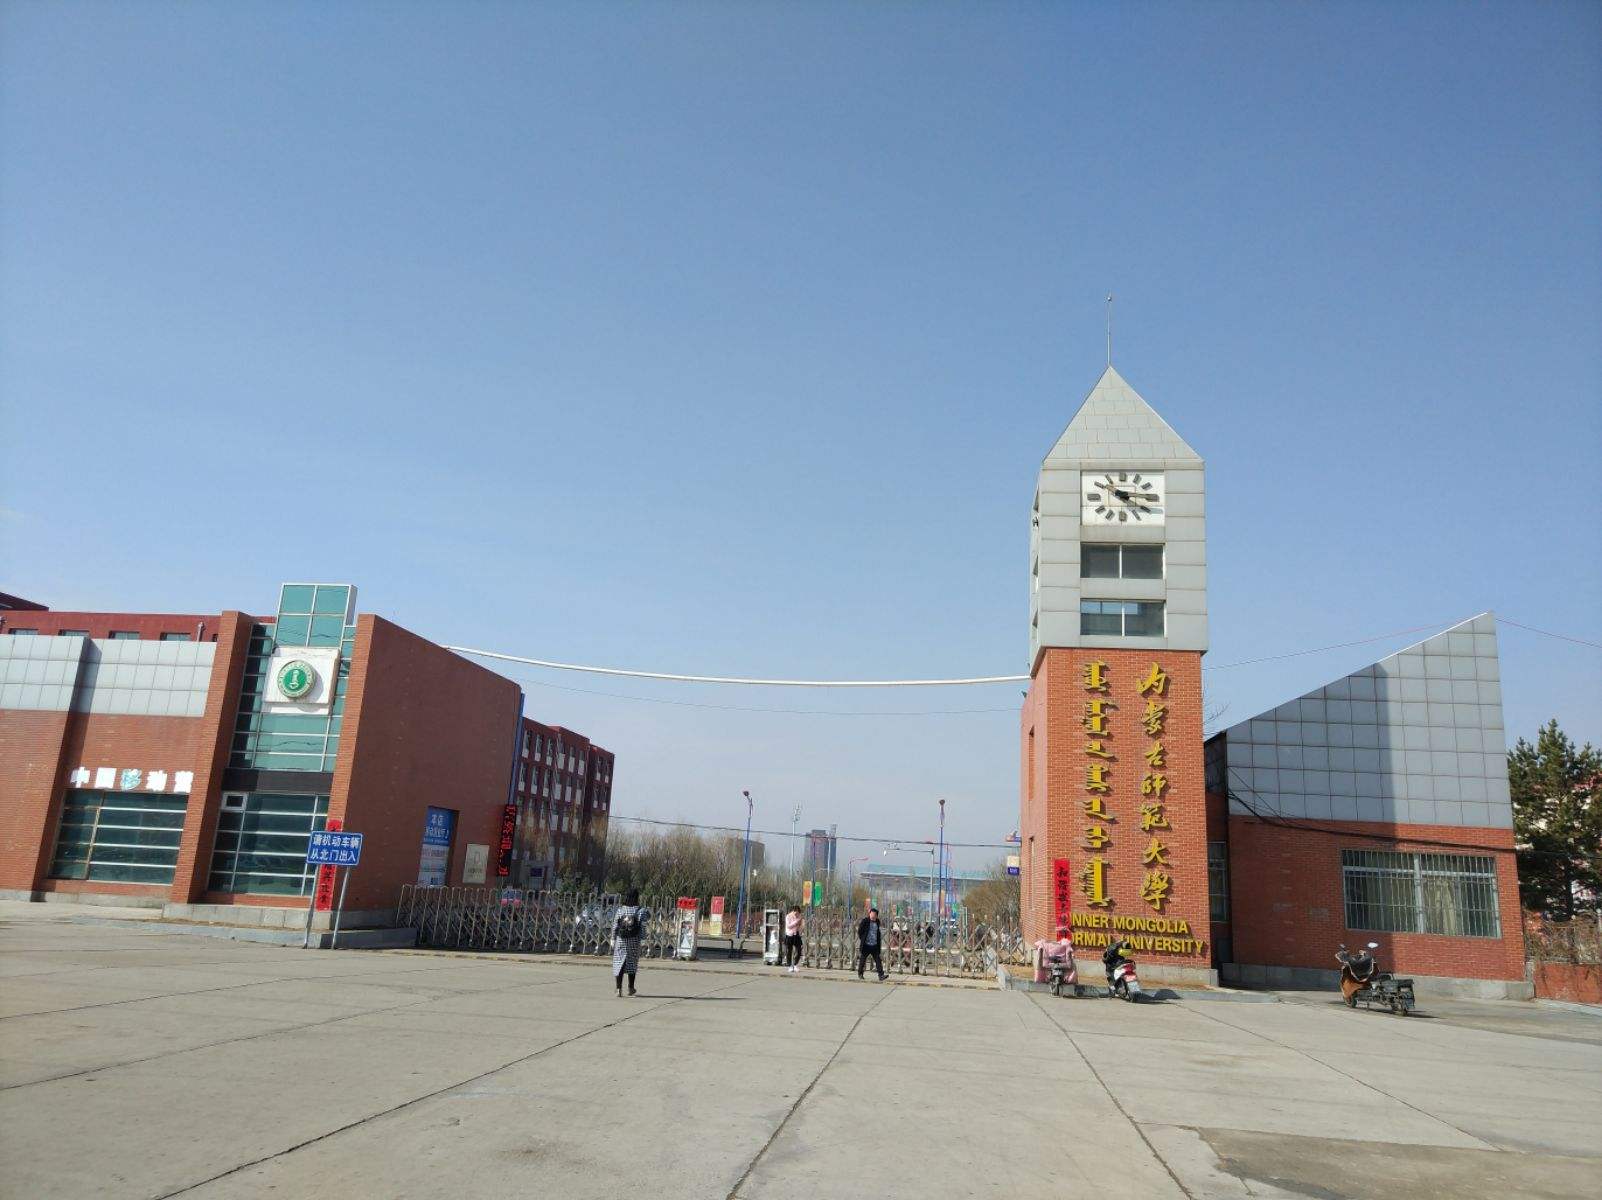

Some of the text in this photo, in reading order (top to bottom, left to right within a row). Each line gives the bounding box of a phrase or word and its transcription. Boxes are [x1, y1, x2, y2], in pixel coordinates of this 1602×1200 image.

[313, 834, 360, 848] 请机动车辆
[310, 848, 356, 862] 从北门出入
[1070, 912, 1188, 934] NNER MONGOLIA
